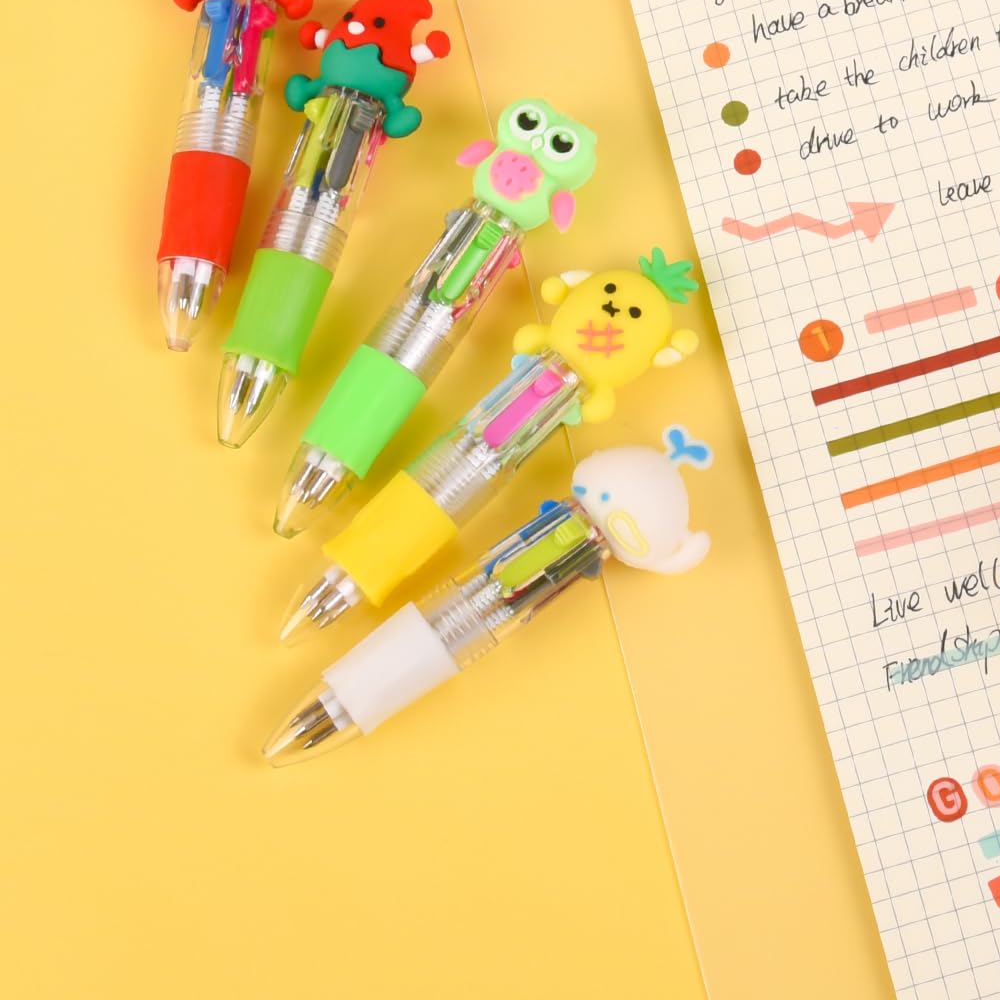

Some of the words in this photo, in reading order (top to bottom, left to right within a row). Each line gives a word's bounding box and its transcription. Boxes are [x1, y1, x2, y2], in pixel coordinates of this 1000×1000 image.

[751, 11, 806, 43] have
[774, 75, 831, 110] take
[843, 58, 879, 88] the
[898, 26, 981, 72] children
[799, 126, 858, 160] drive
[873, 113, 899, 134] to
[937, 174, 993, 206] leave
[871, 591, 923, 628] Live
